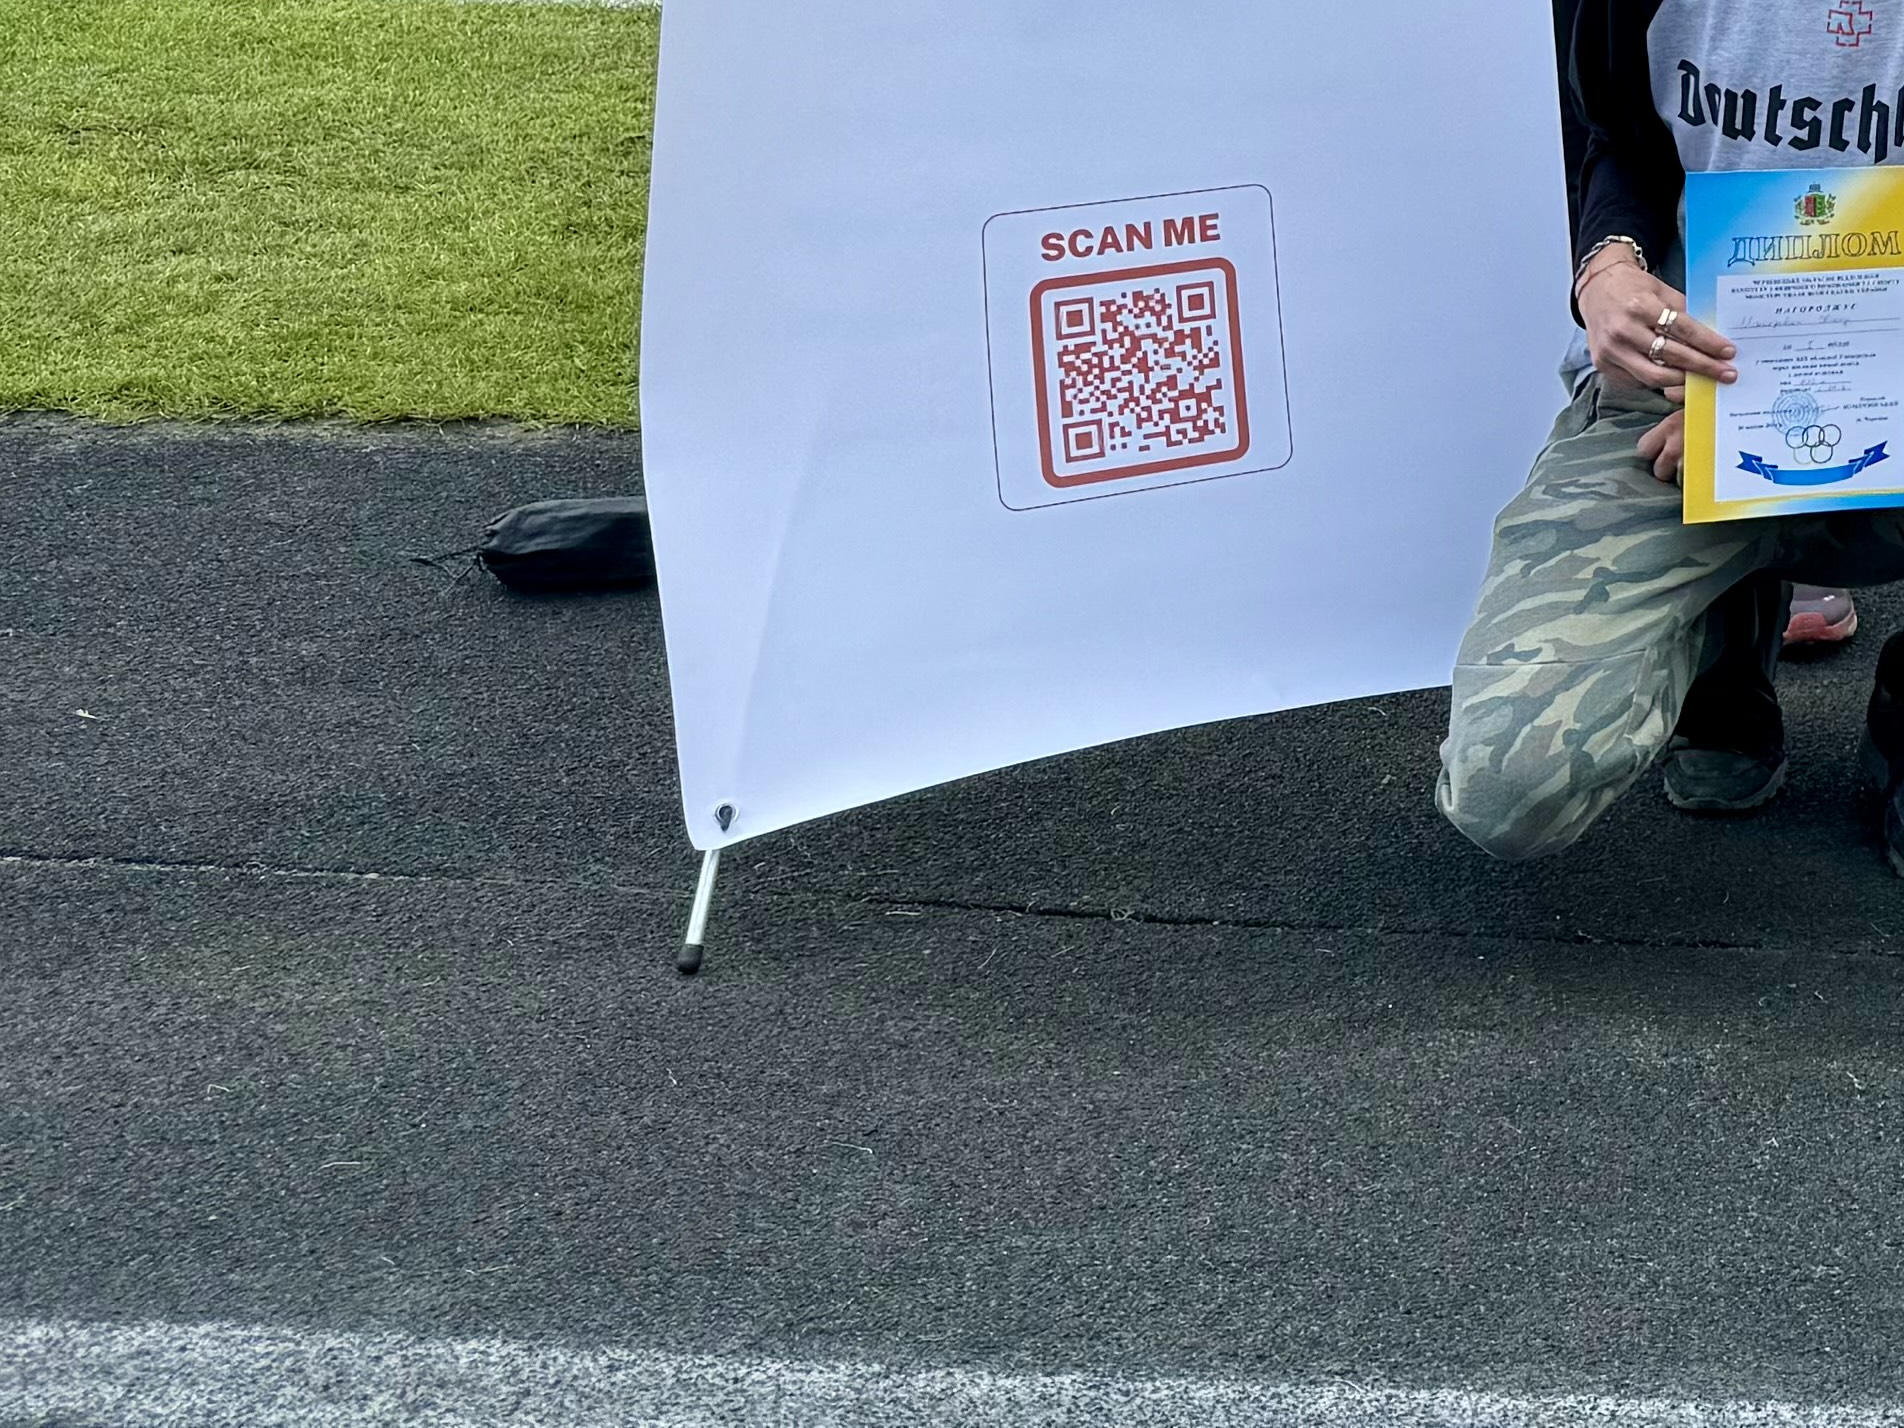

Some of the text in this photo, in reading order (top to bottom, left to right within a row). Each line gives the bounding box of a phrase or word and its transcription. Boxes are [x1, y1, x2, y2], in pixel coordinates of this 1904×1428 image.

[1040, 212, 1221, 262] SCAN ME
[1727, 229, 1903, 268] ДИПЛОМ
